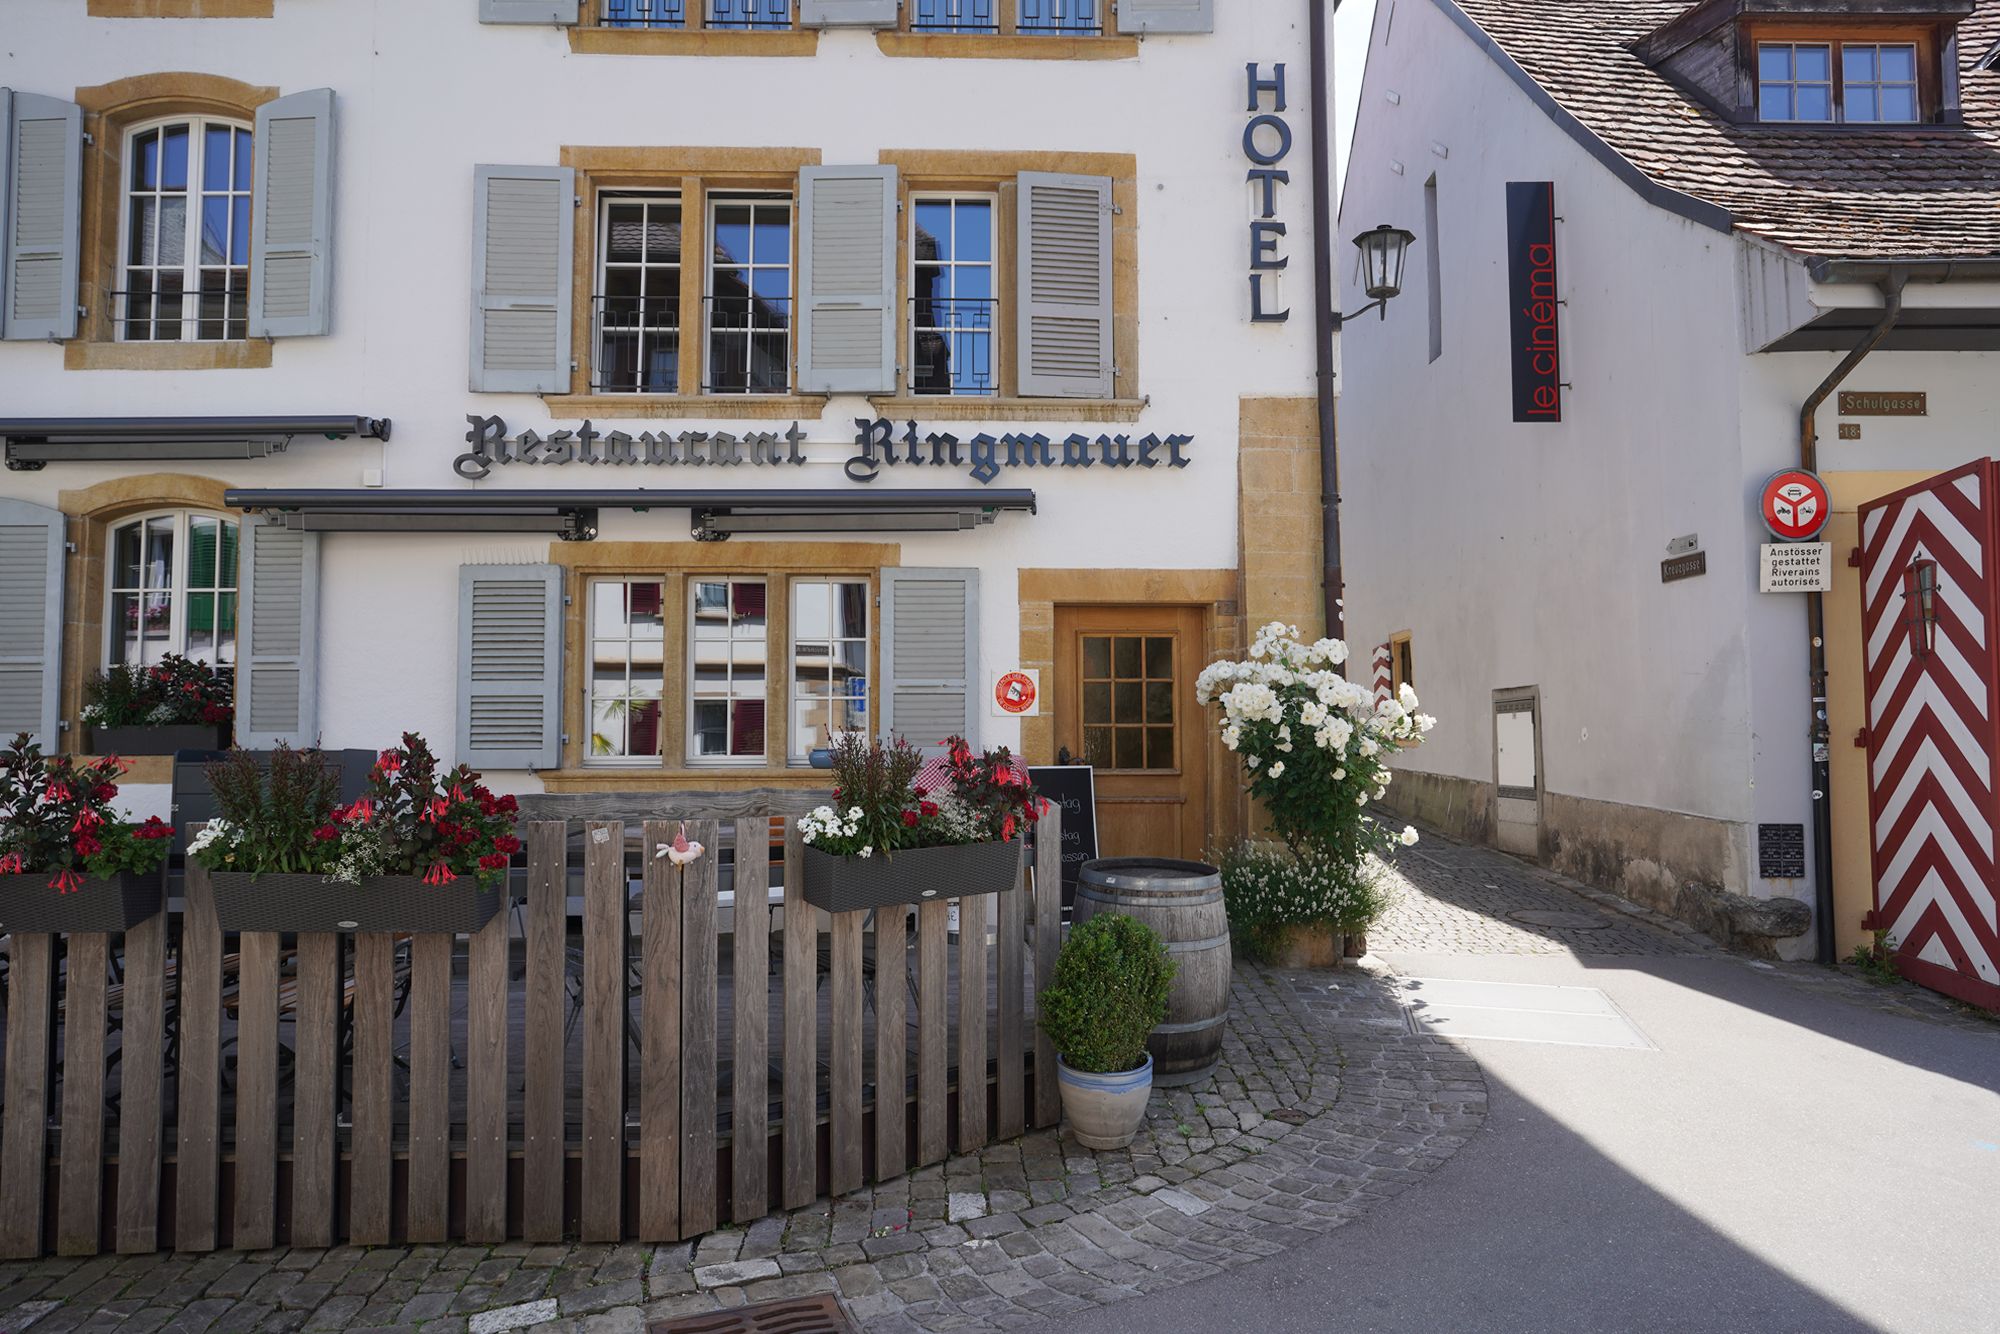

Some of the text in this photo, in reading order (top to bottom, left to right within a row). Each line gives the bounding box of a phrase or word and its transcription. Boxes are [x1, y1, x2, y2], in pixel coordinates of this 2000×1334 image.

[1242, 62, 1292, 323] HOTEL
[1523, 243, 1560, 415] le cinéma
[1846, 396, 1921, 412] Schulgasse
[1843, 426, 1857, 437] 18
[452, 414, 1195, 485] Restaurant Ringmauer
[1769, 547, 1823, 557] Anstösser
[1771, 557, 1821, 568] gestattet
[1771, 567, 1820, 577] Riverains
[1770, 576, 1820, 587] autorisés
